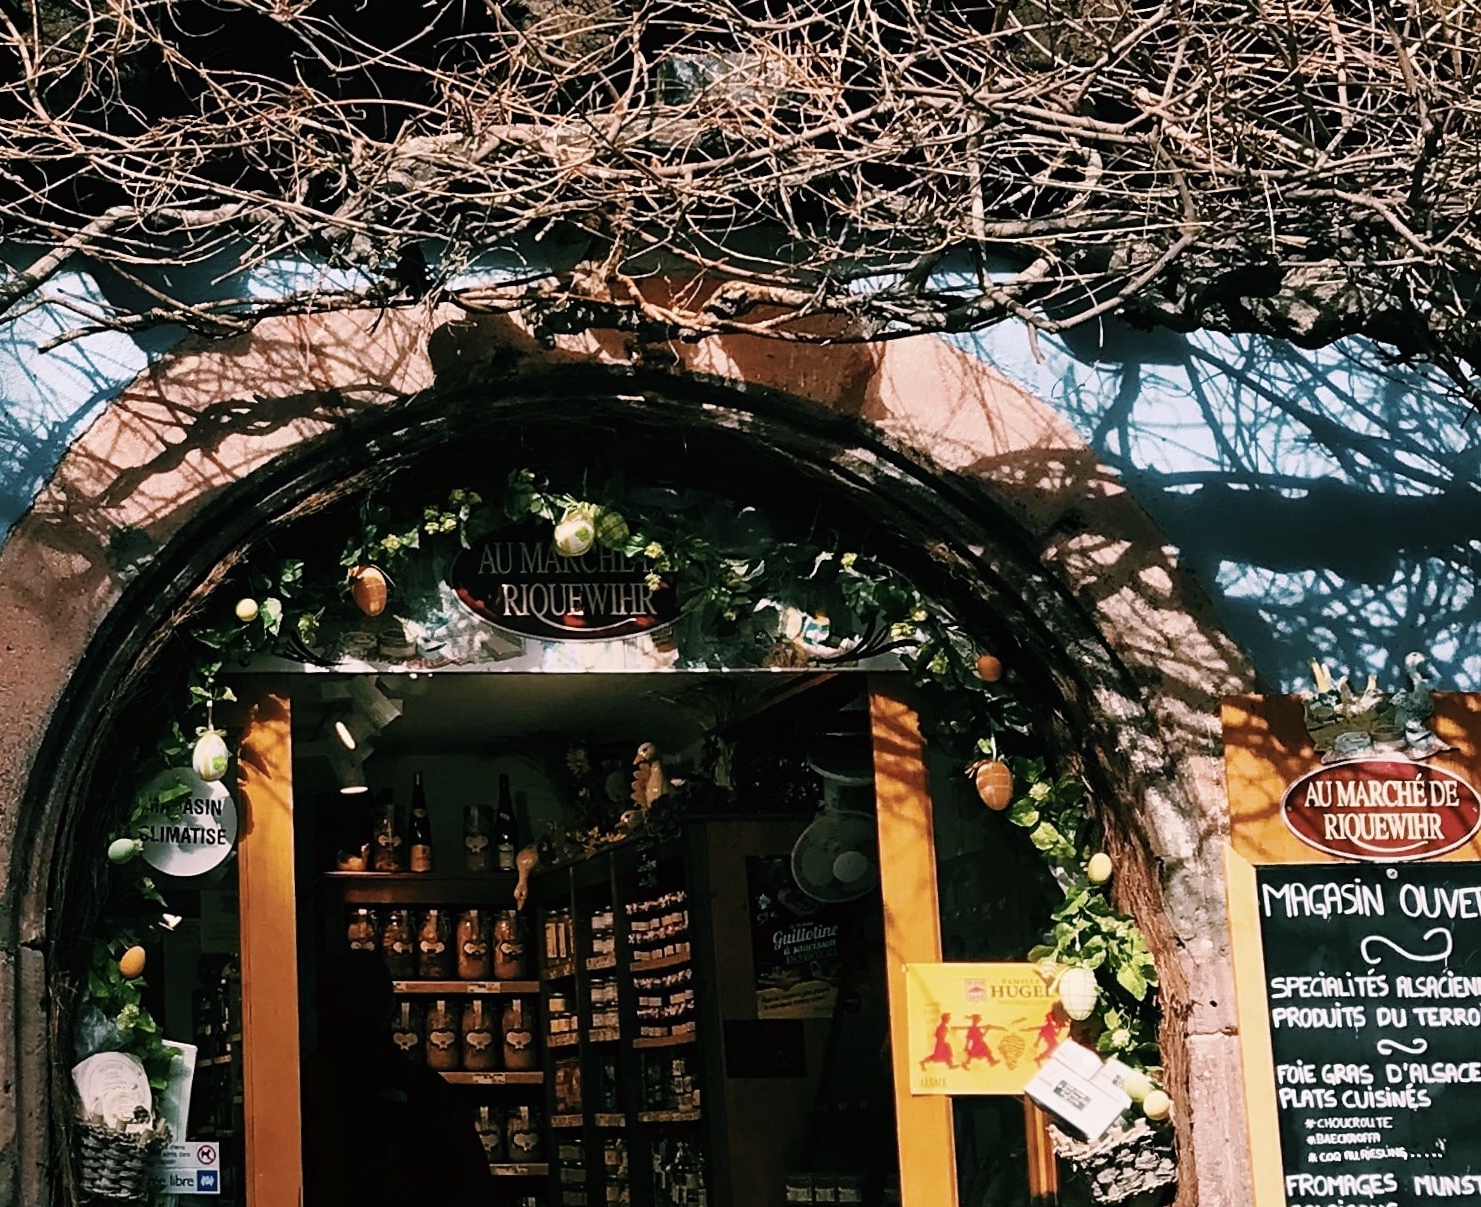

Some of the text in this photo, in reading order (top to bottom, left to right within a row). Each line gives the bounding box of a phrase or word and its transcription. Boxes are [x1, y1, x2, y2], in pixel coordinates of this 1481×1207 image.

[478, 542, 512, 575] AU
[501, 582, 658, 631] RIQUEWIHR
[1304, 773, 1460, 808] AU MARCHÉ DE
[148, 798, 222, 816] ASIN
[1323, 812, 1445, 852] RIQUEWIHR
[1261, 878, 1385, 920] MAGASIN
[990, 985, 1055, 998] HUGEL
[1272, 1002, 1481, 1029] PRODUITS DU TERRO
[1276, 1060, 1481, 1086] FOIE GRAS D'ALSACE
[1278, 1083, 1432, 1110] PLATS CUISINÉS
[1317, 1116, 1393, 1129] CHOUCROUTE
[170, 1173, 195, 1187] libre
[1286, 1173, 1398, 1199] FROMAGES
